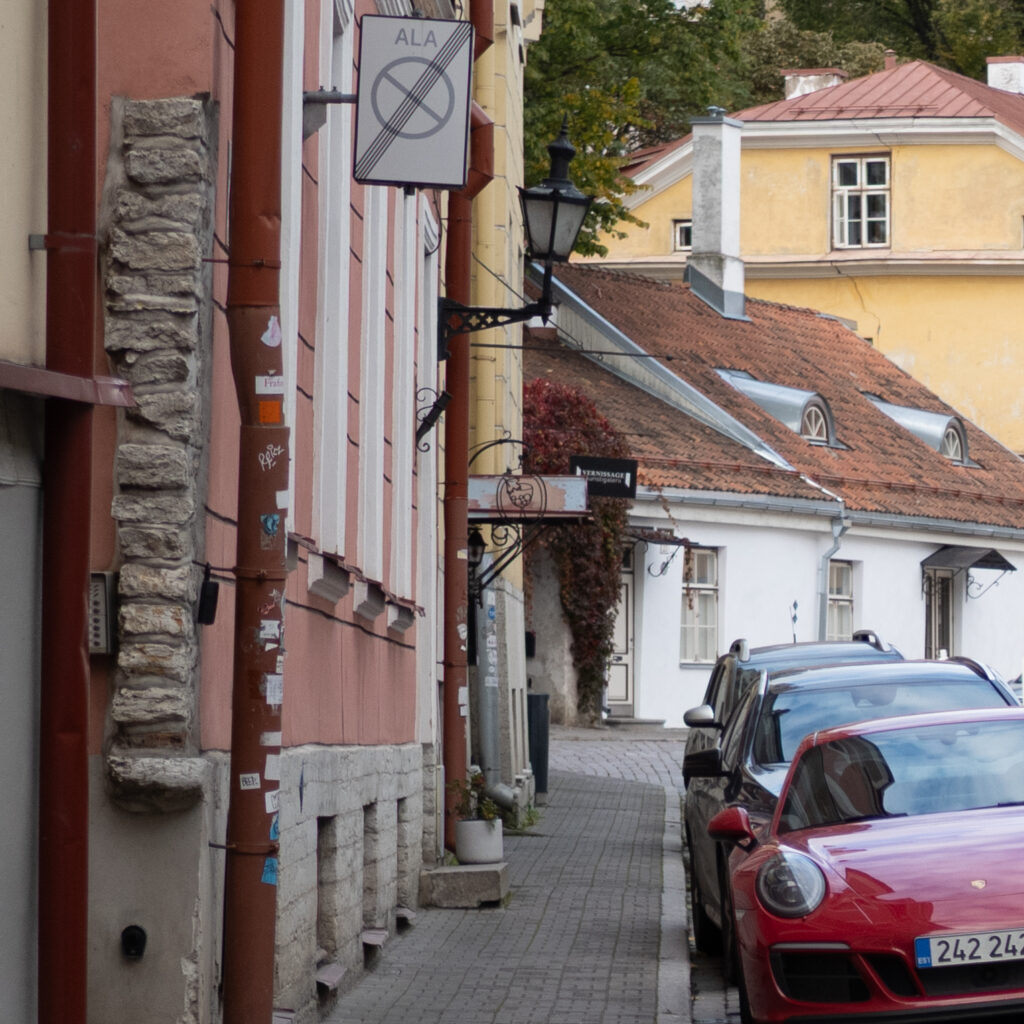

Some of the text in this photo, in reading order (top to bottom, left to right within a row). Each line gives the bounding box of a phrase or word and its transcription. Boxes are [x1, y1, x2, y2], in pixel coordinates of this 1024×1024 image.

[394, 27, 437, 48] ALA
[582, 469, 625, 479] VERNISSAGE
[937, 937, 982, 963] 242
